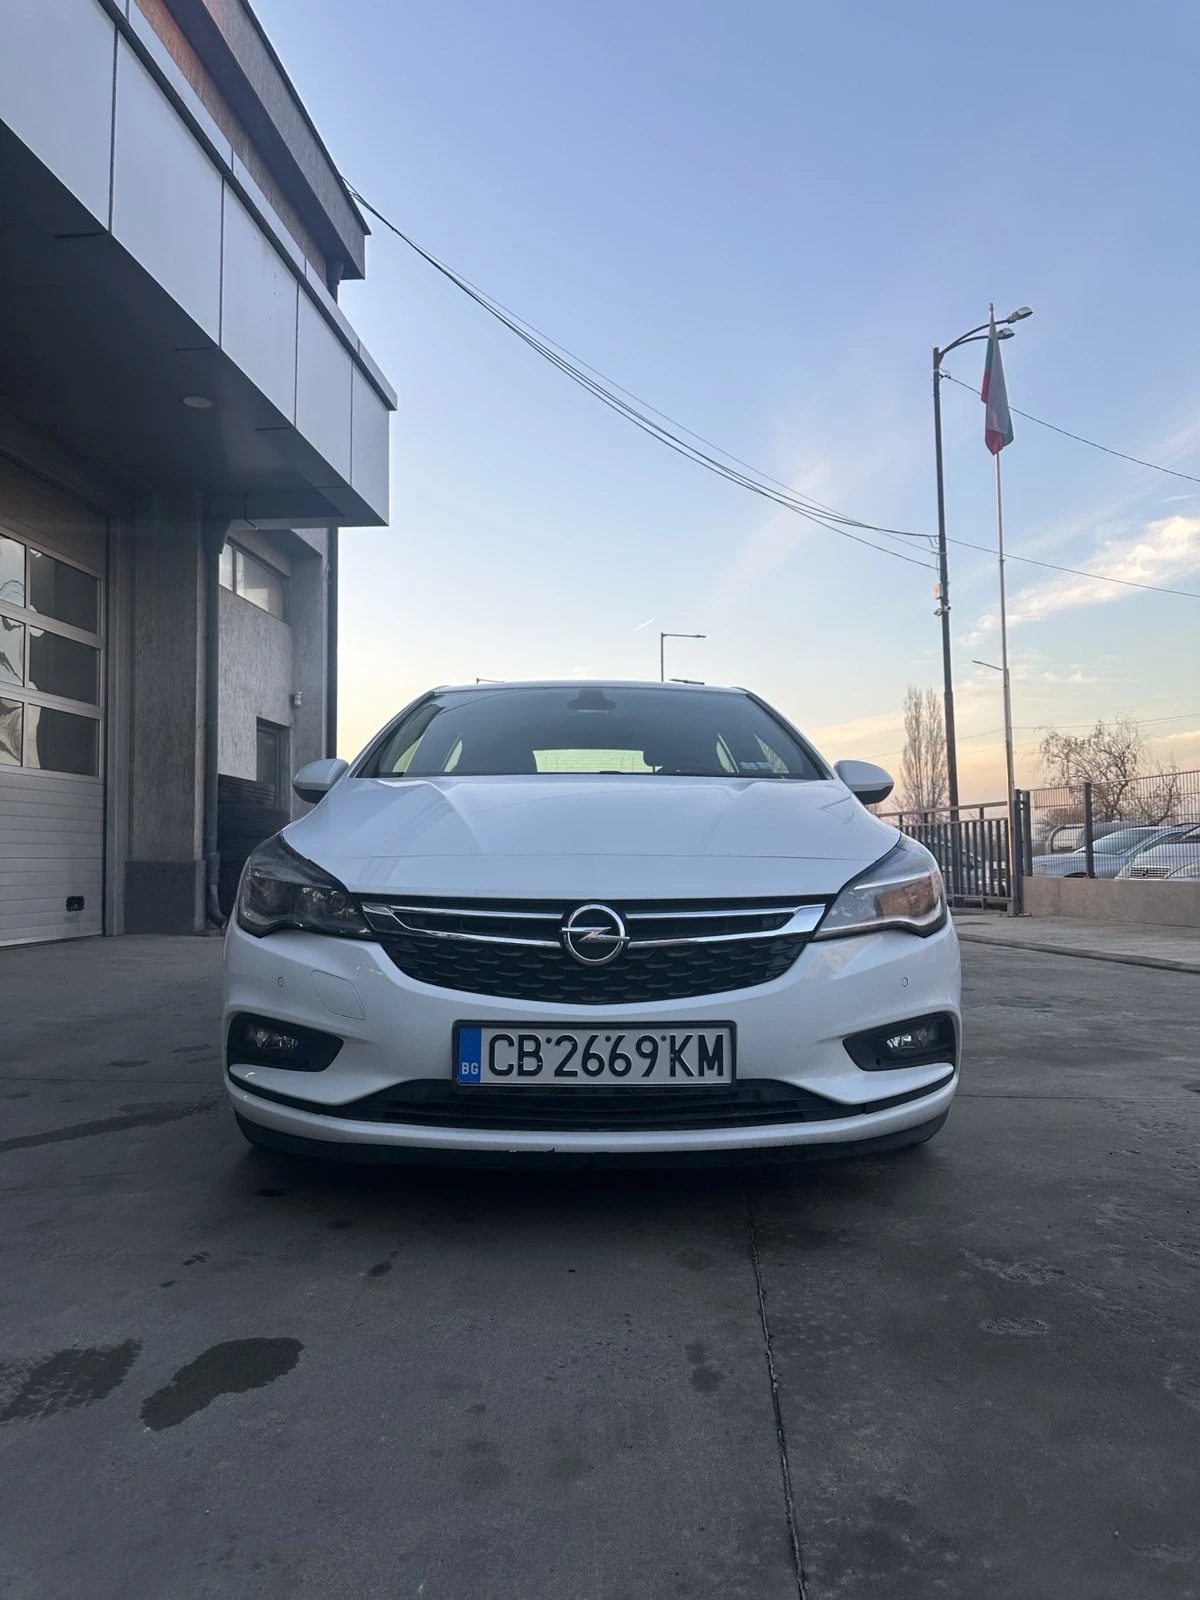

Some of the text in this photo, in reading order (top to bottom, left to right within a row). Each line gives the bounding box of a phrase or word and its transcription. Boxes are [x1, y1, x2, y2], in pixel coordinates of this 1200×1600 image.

[461, 1062, 479, 1075] BG
[489, 1033, 724, 1077] CB 2669 KM
